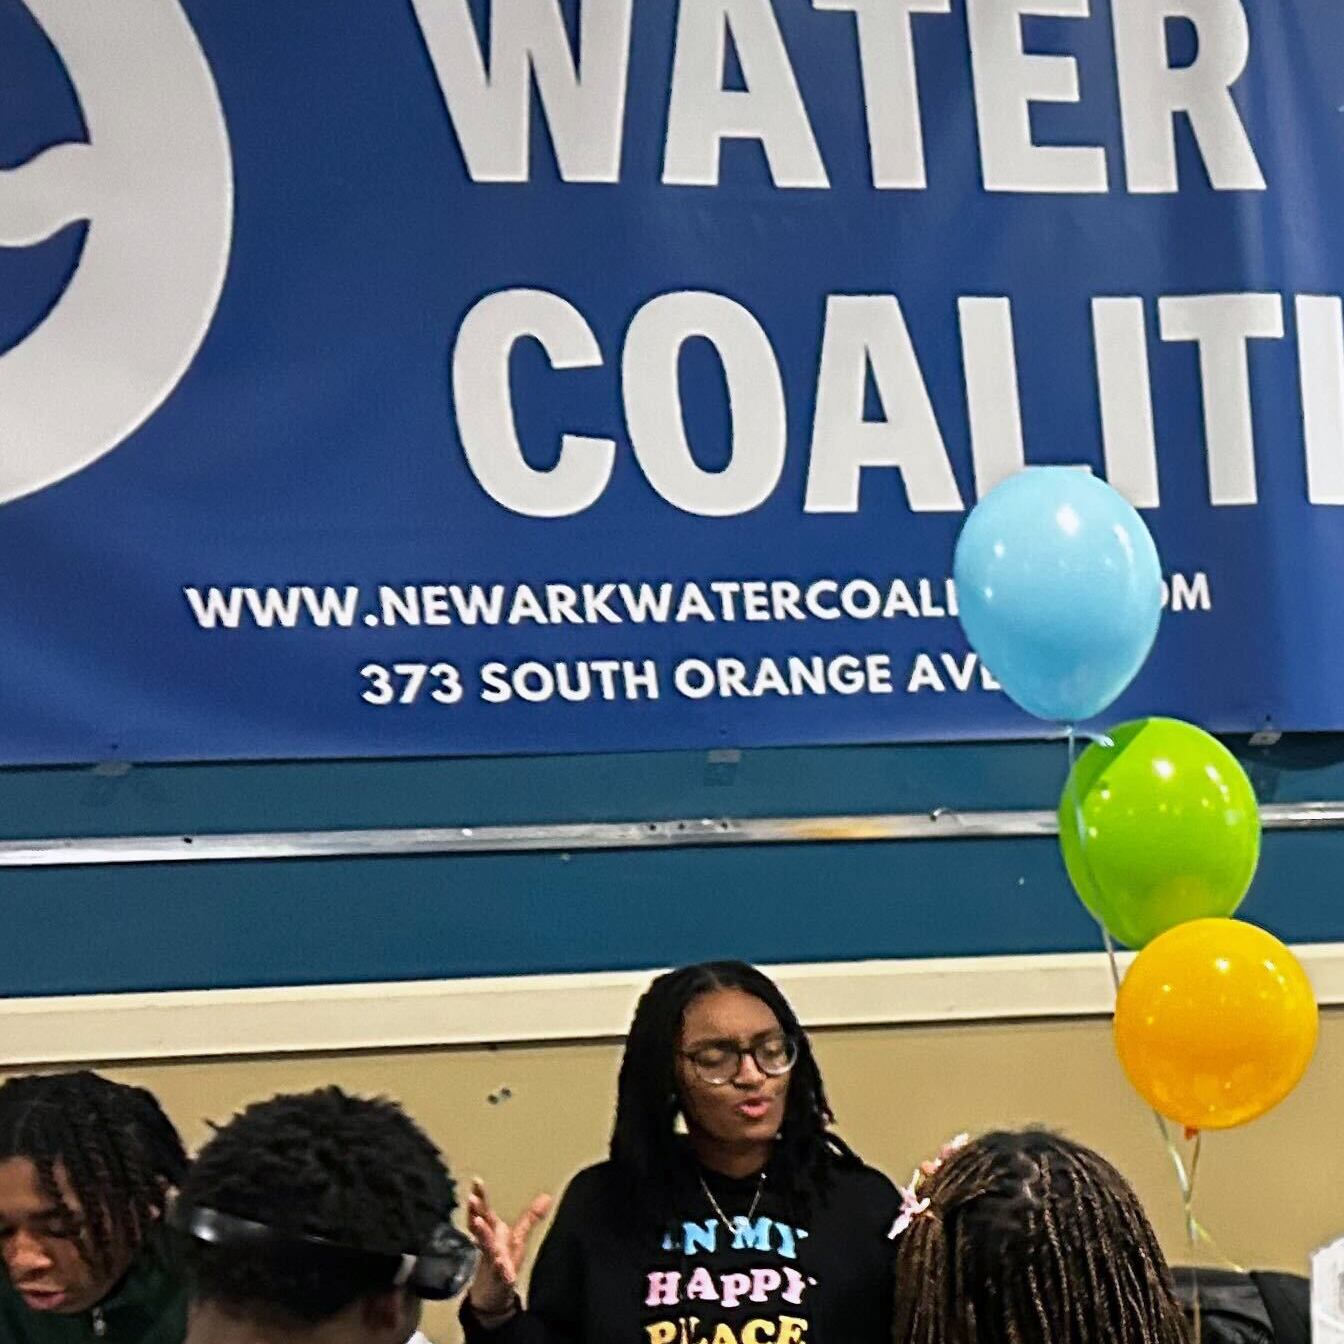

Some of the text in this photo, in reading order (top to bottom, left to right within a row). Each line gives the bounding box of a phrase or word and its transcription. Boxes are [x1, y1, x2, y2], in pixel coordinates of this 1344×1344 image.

[414, 0, 1267, 192] WATER
[361, 664, 463, 704] 373
[480, 659, 656, 703] SOUTH
[675, 652, 893, 700] ORANGE
[728, 1215, 810, 1259] MY
[644, 1265, 818, 1308] HAPPY
